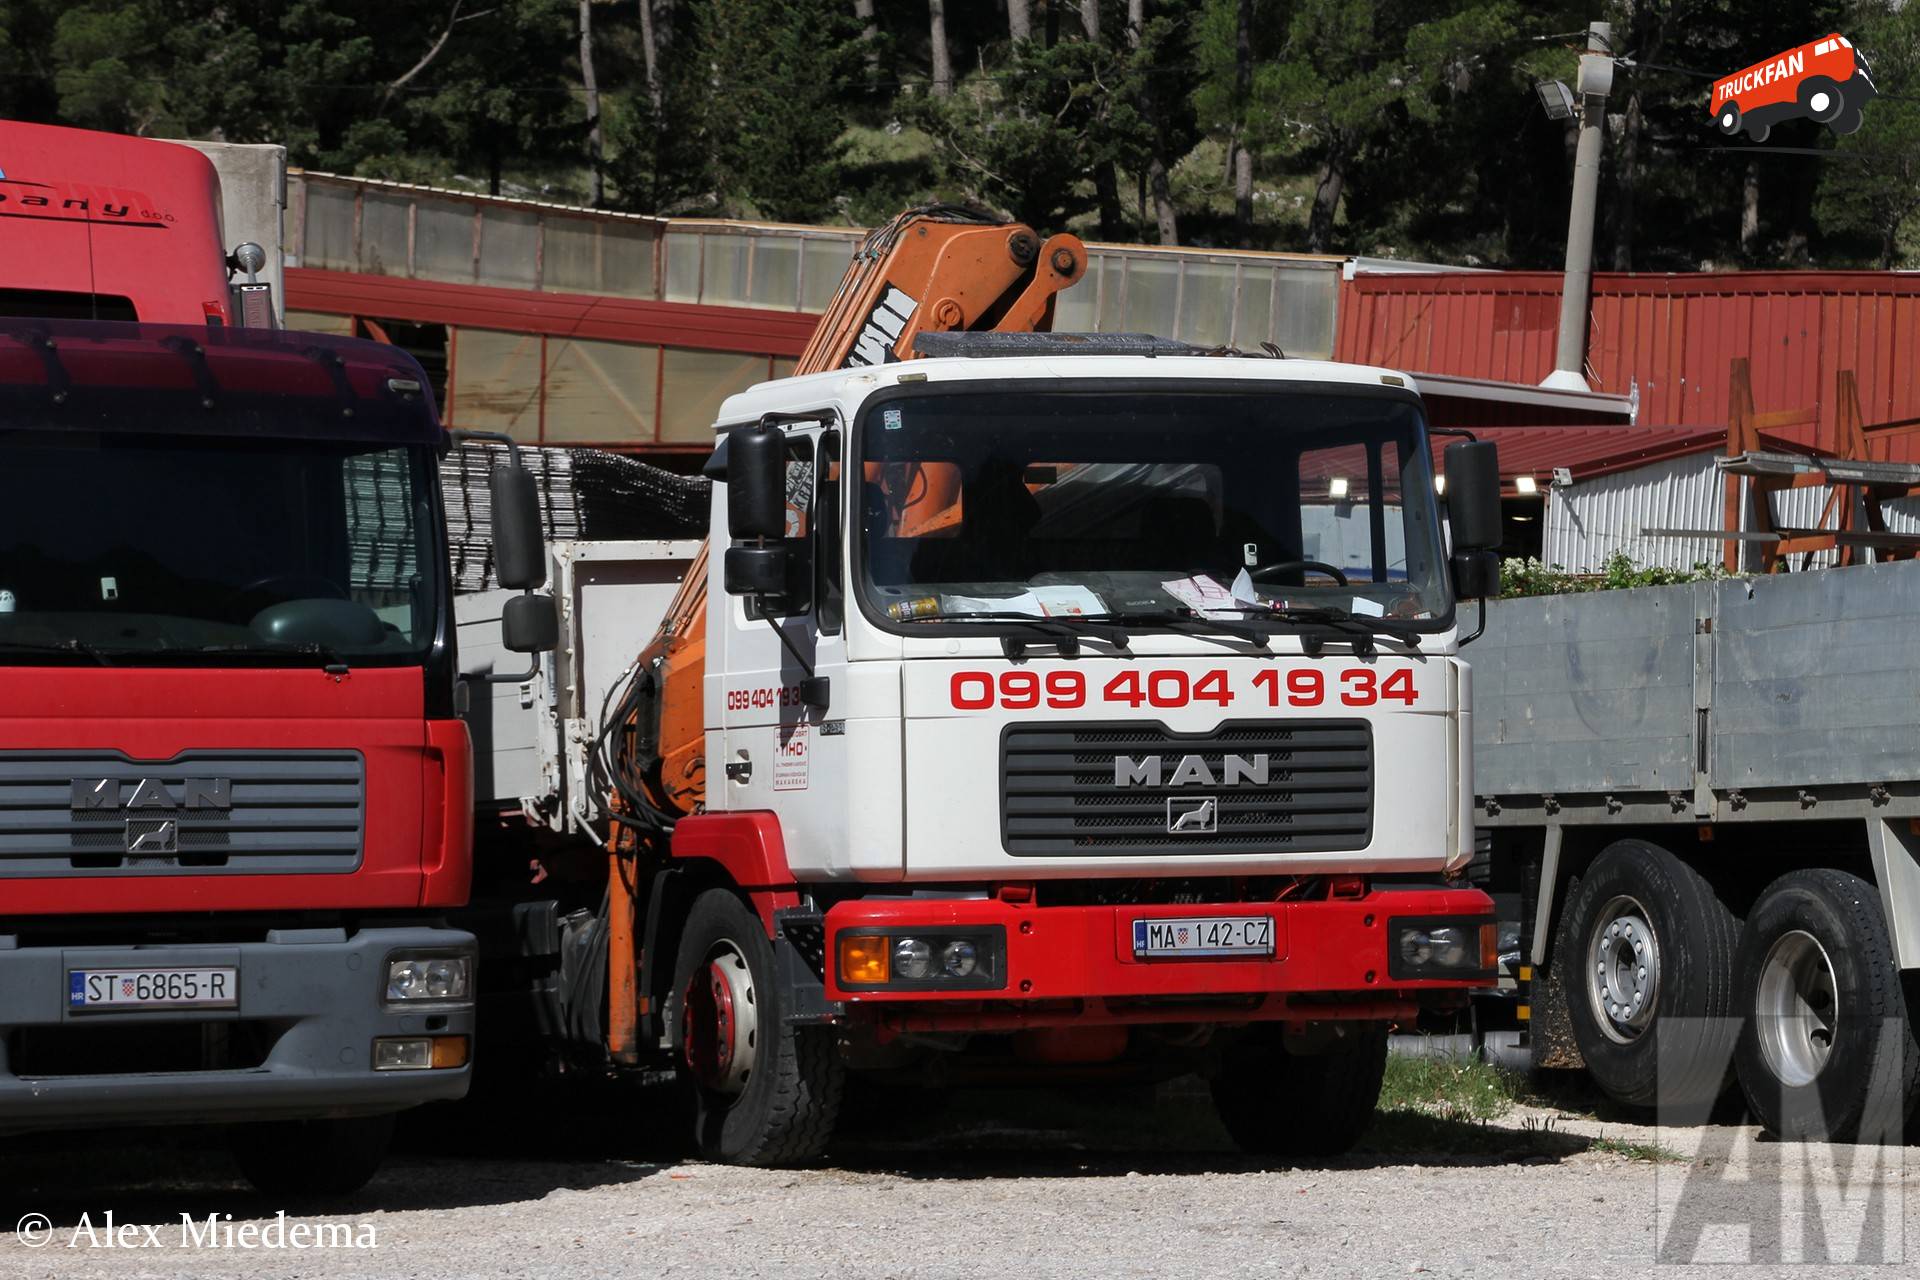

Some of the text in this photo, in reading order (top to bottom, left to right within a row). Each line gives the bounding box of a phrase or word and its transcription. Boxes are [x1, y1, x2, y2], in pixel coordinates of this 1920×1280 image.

[728, 691, 749, 710] 099
[752, 688, 773, 709] 404
[950, 671, 1086, 709] 099
[1103, 670, 1235, 708] 404
[1114, 753, 1271, 788] MAN
[70, 777, 232, 809] MAN
[1150, 922, 1269, 949] MA 142-CZ
[71, 992, 84, 1001] HR
[88, 973, 225, 1001] ST 6865-R
